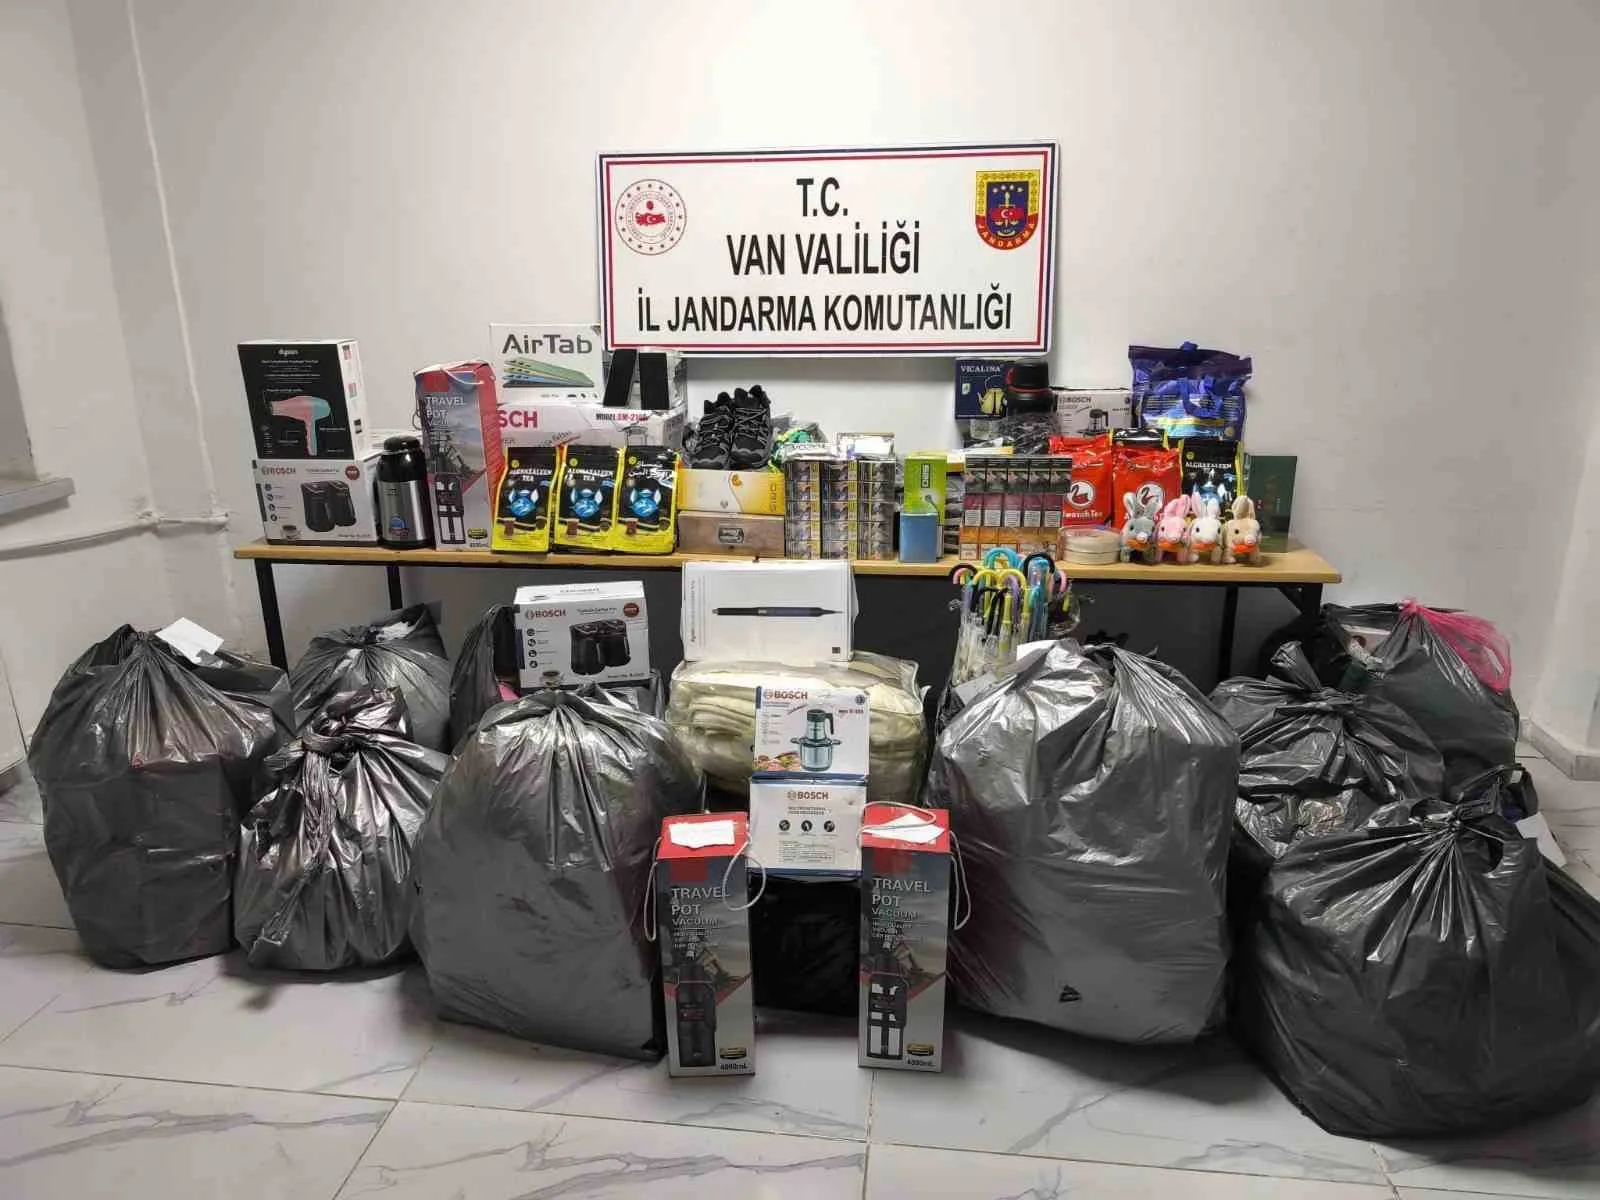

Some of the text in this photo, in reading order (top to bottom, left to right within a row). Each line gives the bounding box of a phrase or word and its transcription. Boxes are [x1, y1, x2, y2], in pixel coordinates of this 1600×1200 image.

[796, 177, 849, 217] T.C.
[726, 220, 920, 275] VAN VALİLİĞİ
[637, 282, 1012, 332] İL JANDARMA KOMUTANLIĞI
[502, 333, 593, 354] AirTab
[498, 410, 538, 429] SCH
[535, 608, 567, 618] BOSCH
[774, 688, 808, 700] BOSCH
[797, 791, 829, 800] BOSCH
[871, 877, 931, 893] TRAVEL
[671, 886, 730, 899] TRAVEL
[872, 894, 901, 907] POT
[671, 904, 701, 916] POT
